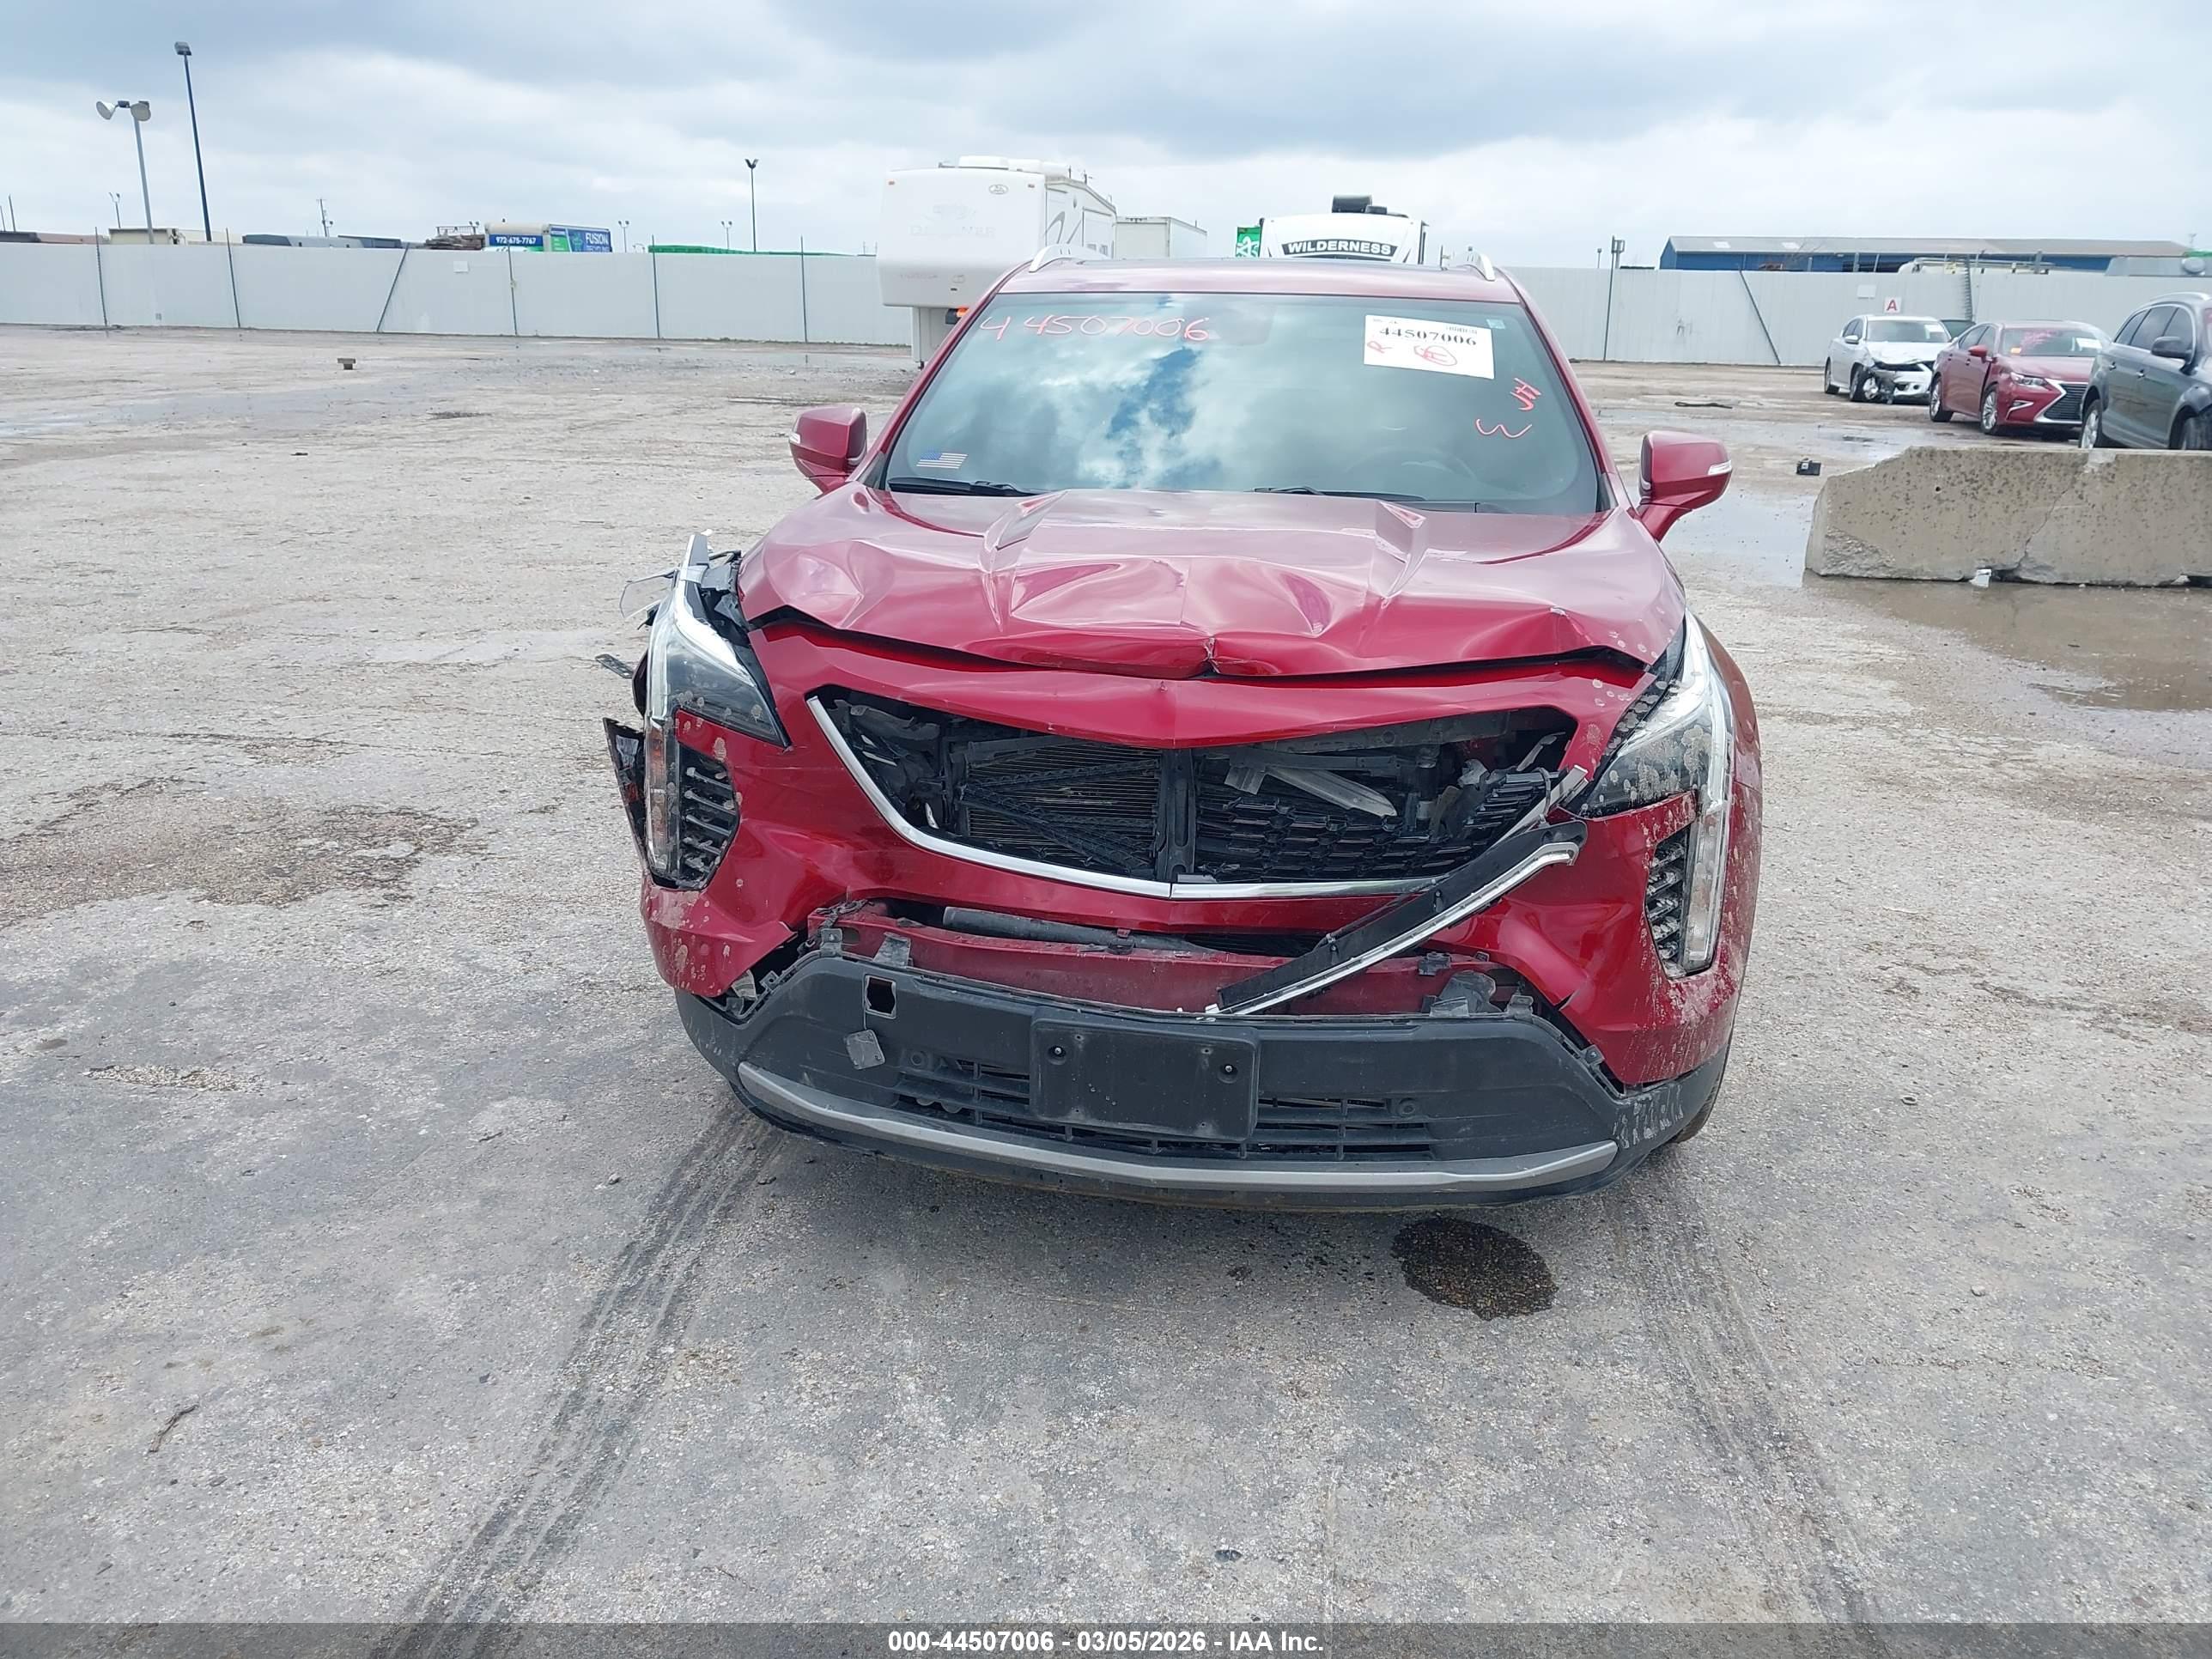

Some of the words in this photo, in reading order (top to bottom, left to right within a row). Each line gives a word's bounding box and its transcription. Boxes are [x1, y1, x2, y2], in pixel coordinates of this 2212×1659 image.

[585, 232, 610, 245] FUSION
[1287, 240, 1392, 256] WILDERNESS
[1886, 299, 1898, 311] A
[1379, 326, 1478, 346] 44507006
